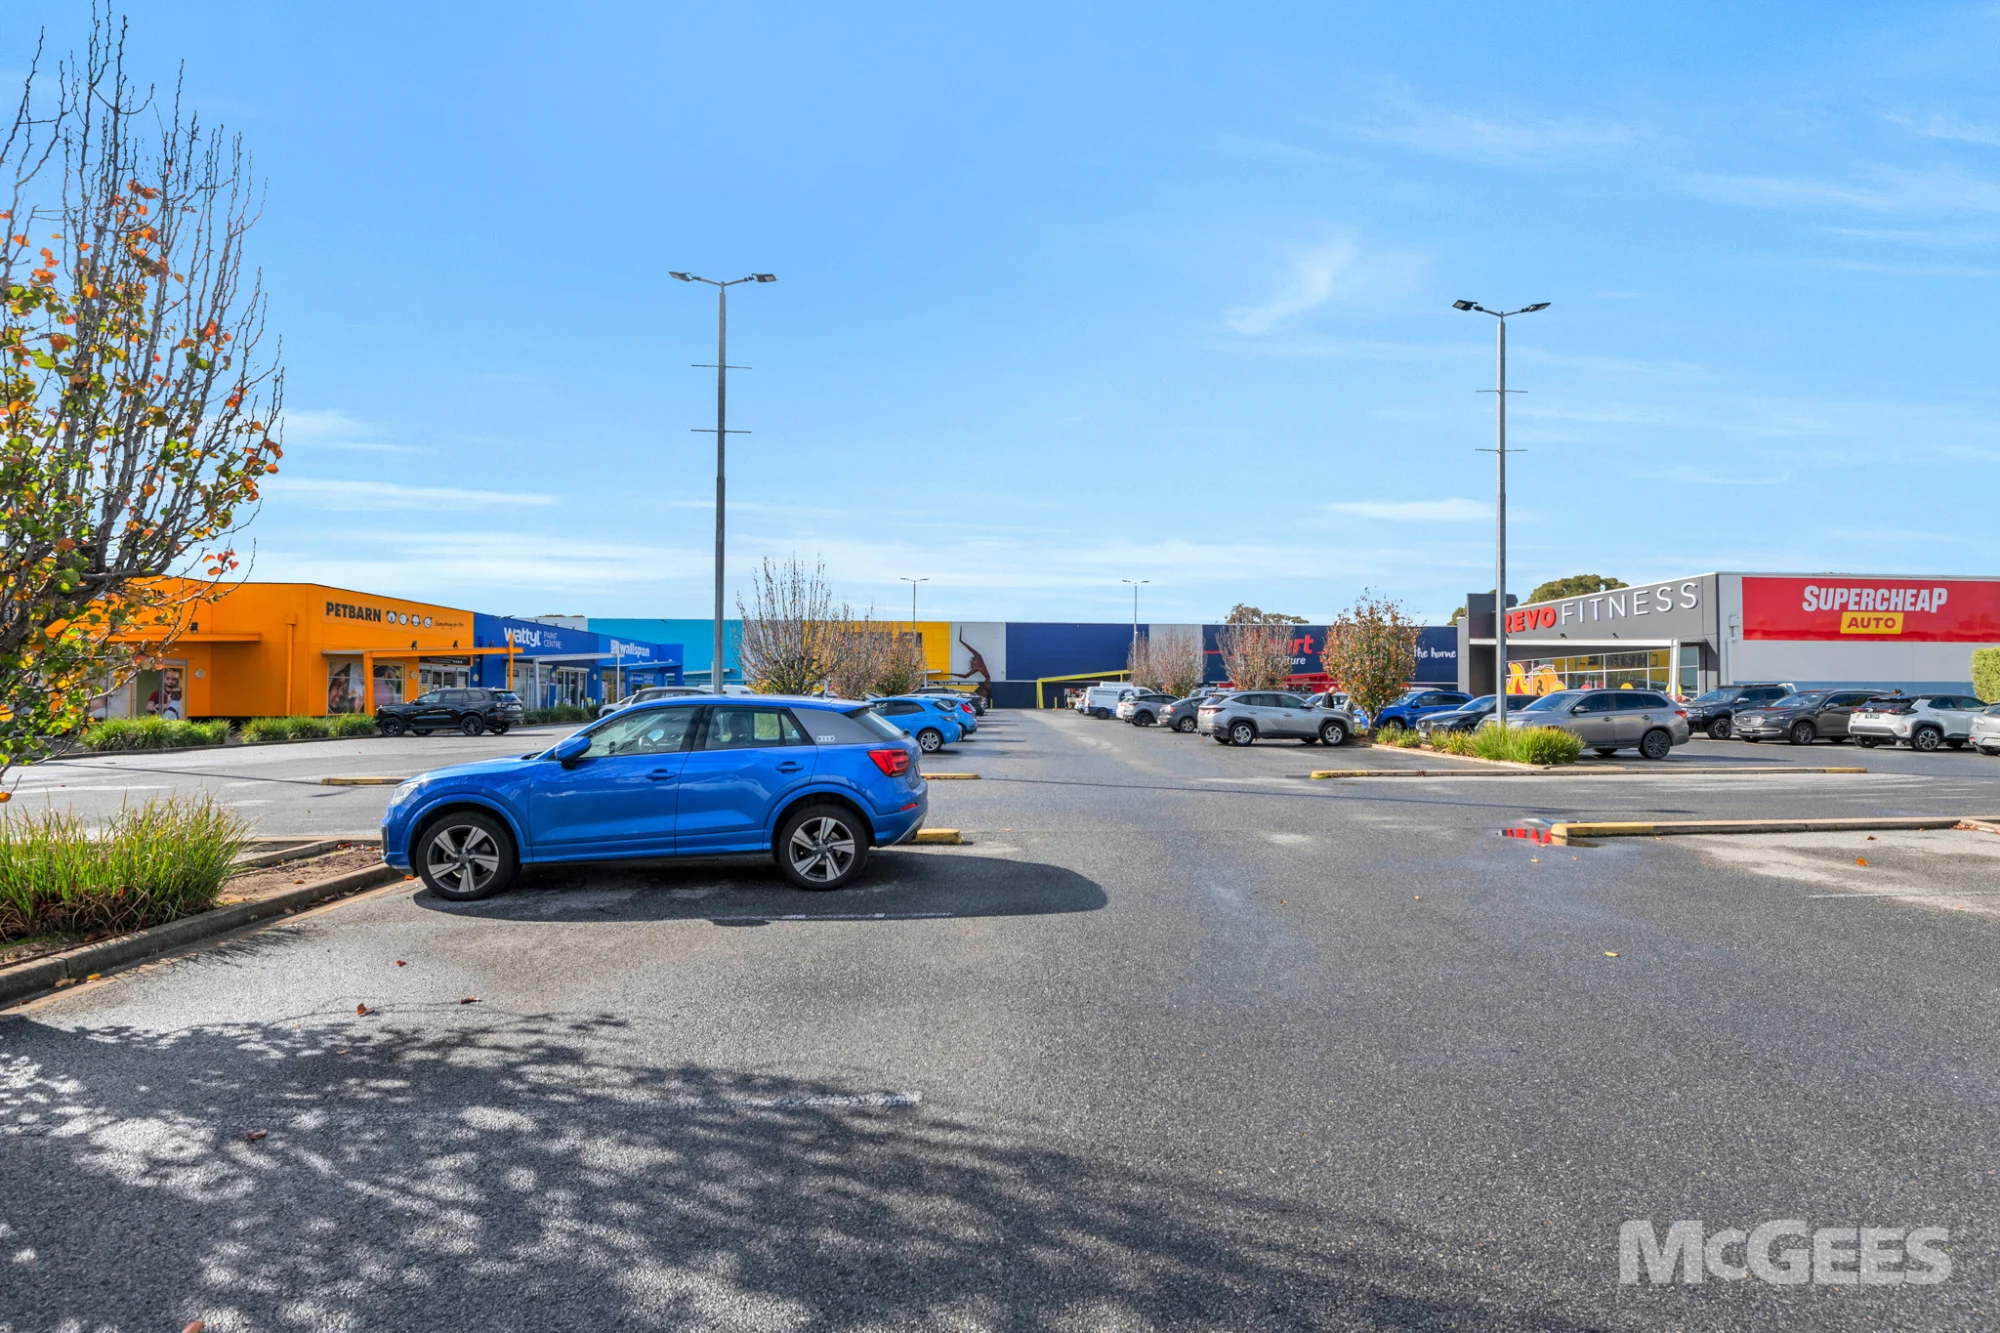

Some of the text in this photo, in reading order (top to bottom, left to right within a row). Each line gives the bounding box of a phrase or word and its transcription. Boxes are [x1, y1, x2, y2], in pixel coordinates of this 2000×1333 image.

[1802, 585, 1948, 613] SUPERCHEAP
[325, 601, 382, 623] PETBARN
[1505, 582, 1699, 633] REVO FITNESS
[1847, 617, 1897, 629] AUTO
[503, 626, 541, 648] wattyl
[543, 631, 558, 640] PAINT
[543, 639, 562, 649] CENTRE
[619, 642, 650, 658] wallspan
[1430, 646, 1457, 659] home
